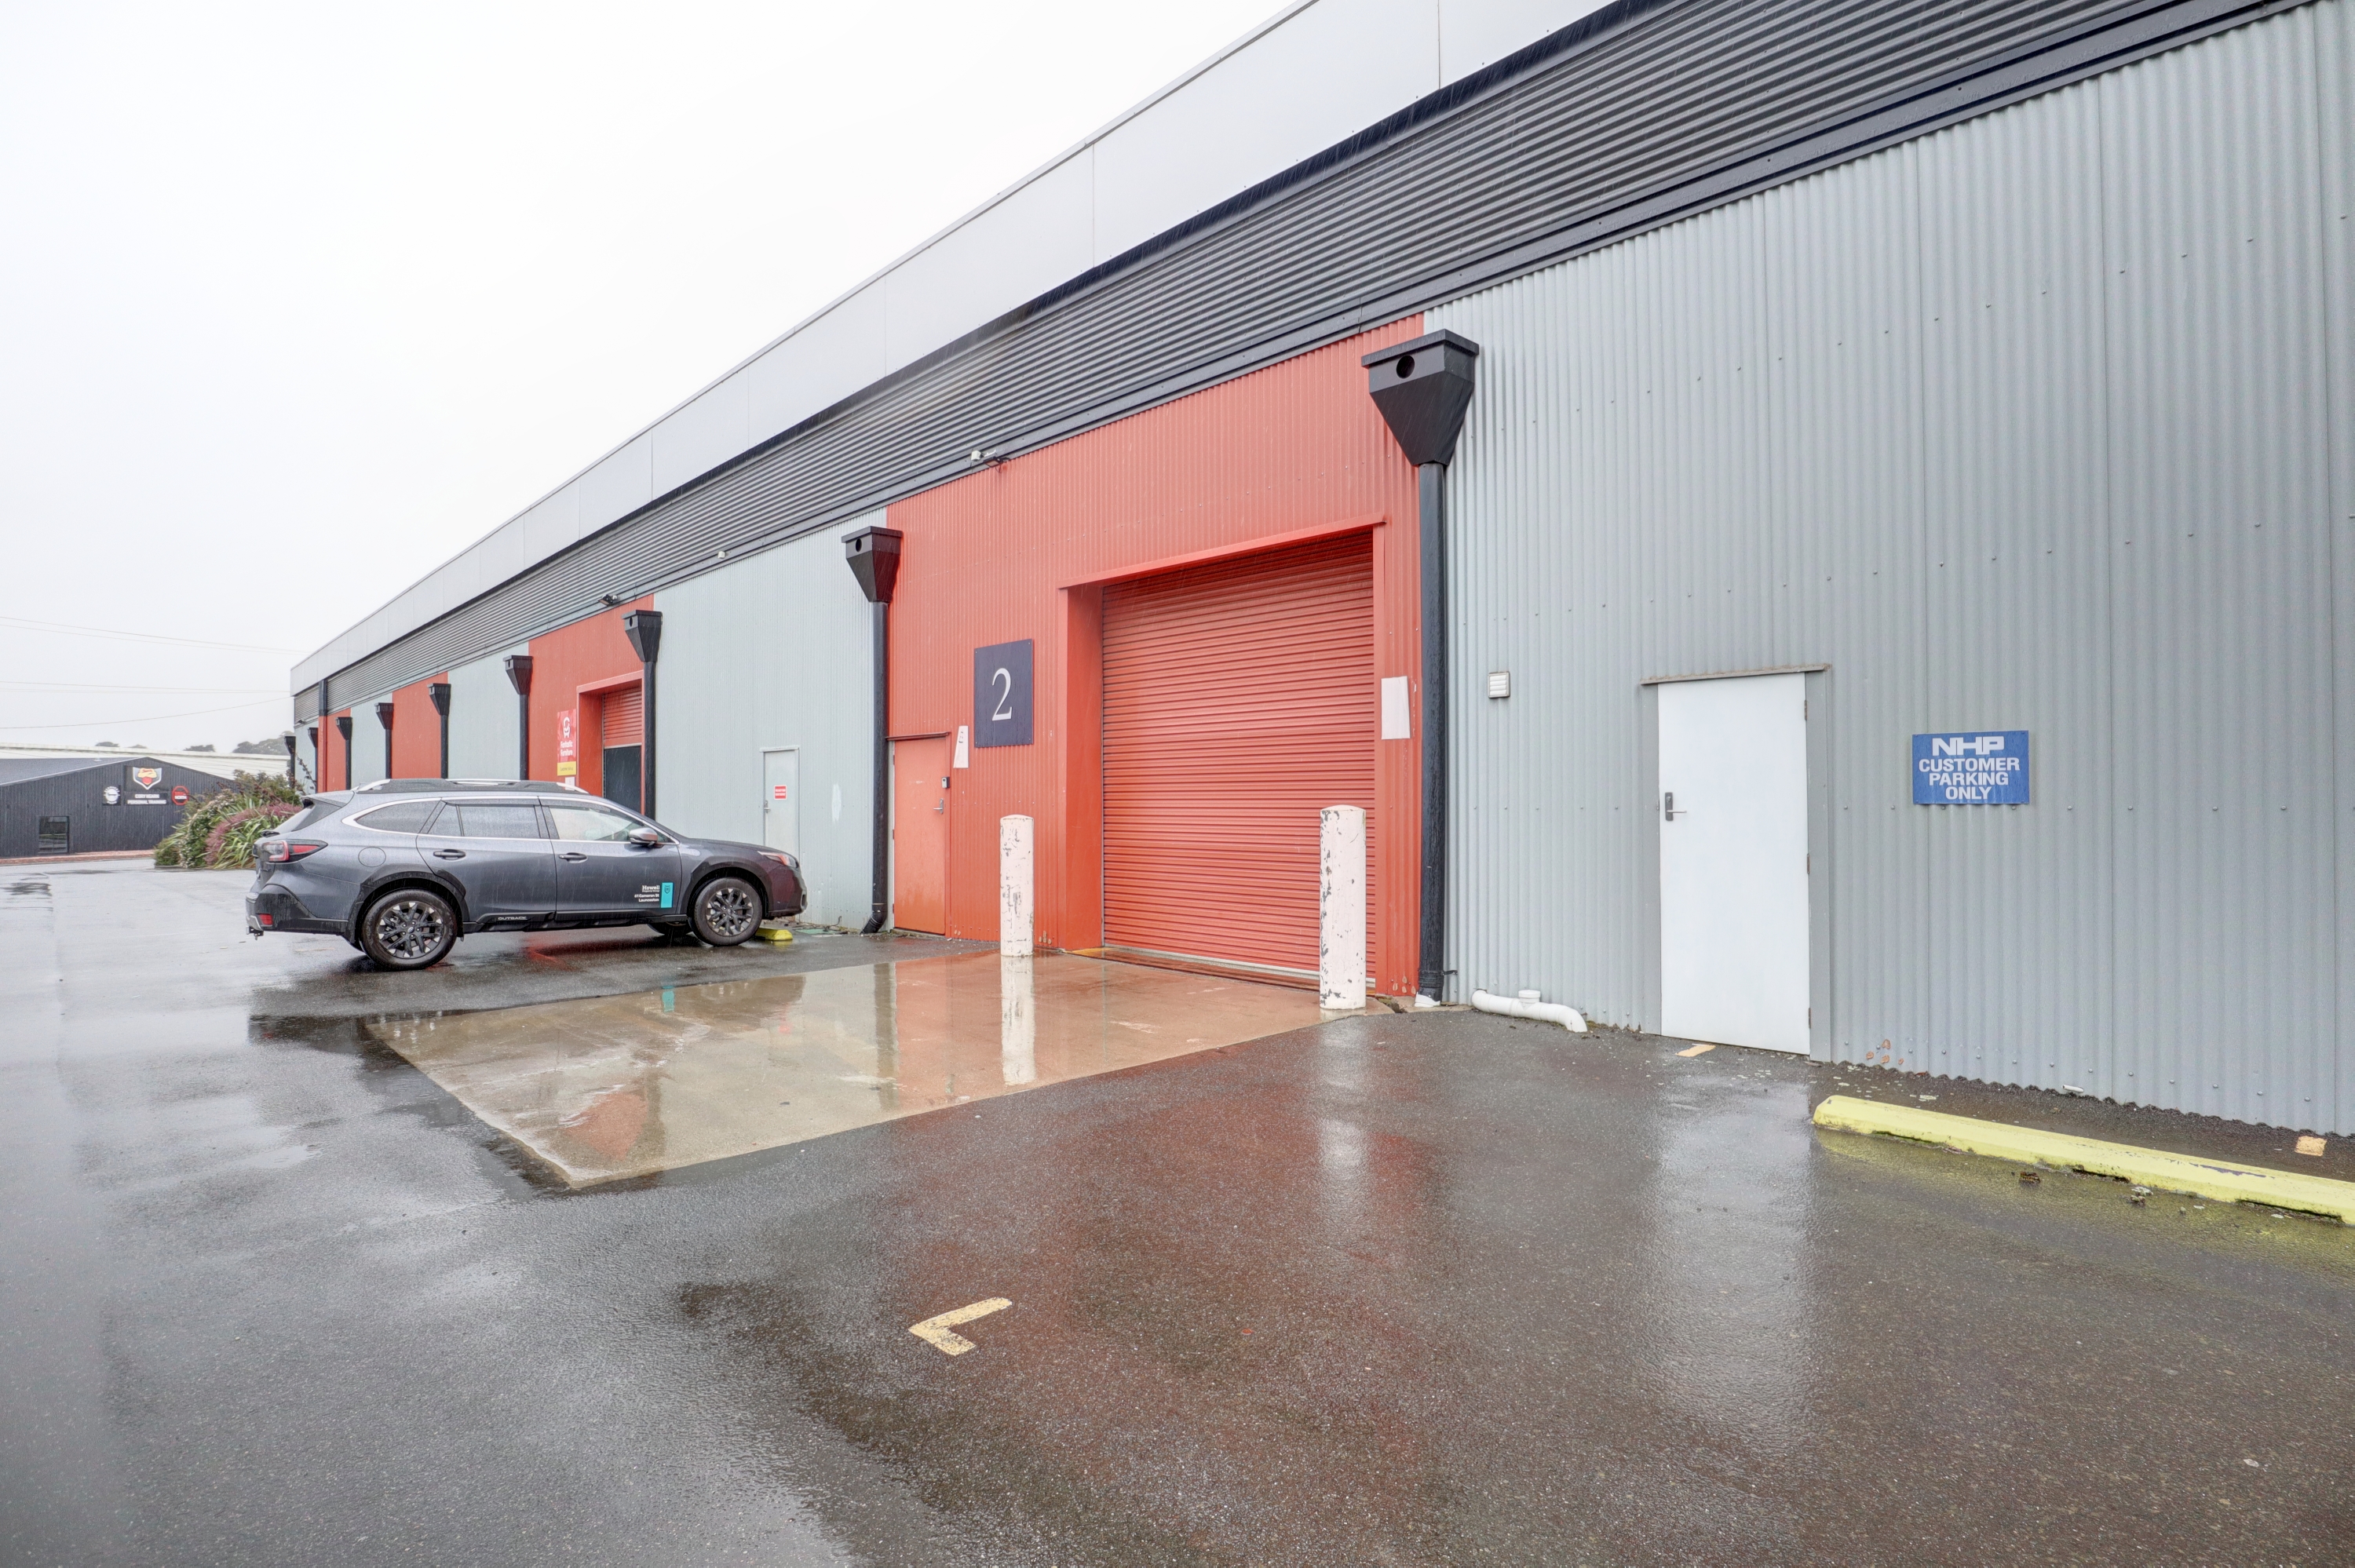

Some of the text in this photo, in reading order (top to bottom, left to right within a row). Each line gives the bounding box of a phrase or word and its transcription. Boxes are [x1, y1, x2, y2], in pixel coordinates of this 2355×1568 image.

[991, 667, 1013, 721] 2
[1932, 735, 2005, 757] NHP
[1919, 757, 2021, 772] CUSTOMER
[1929, 771, 2009, 786] PARKING
[1945, 786, 1992, 800] ONLY
